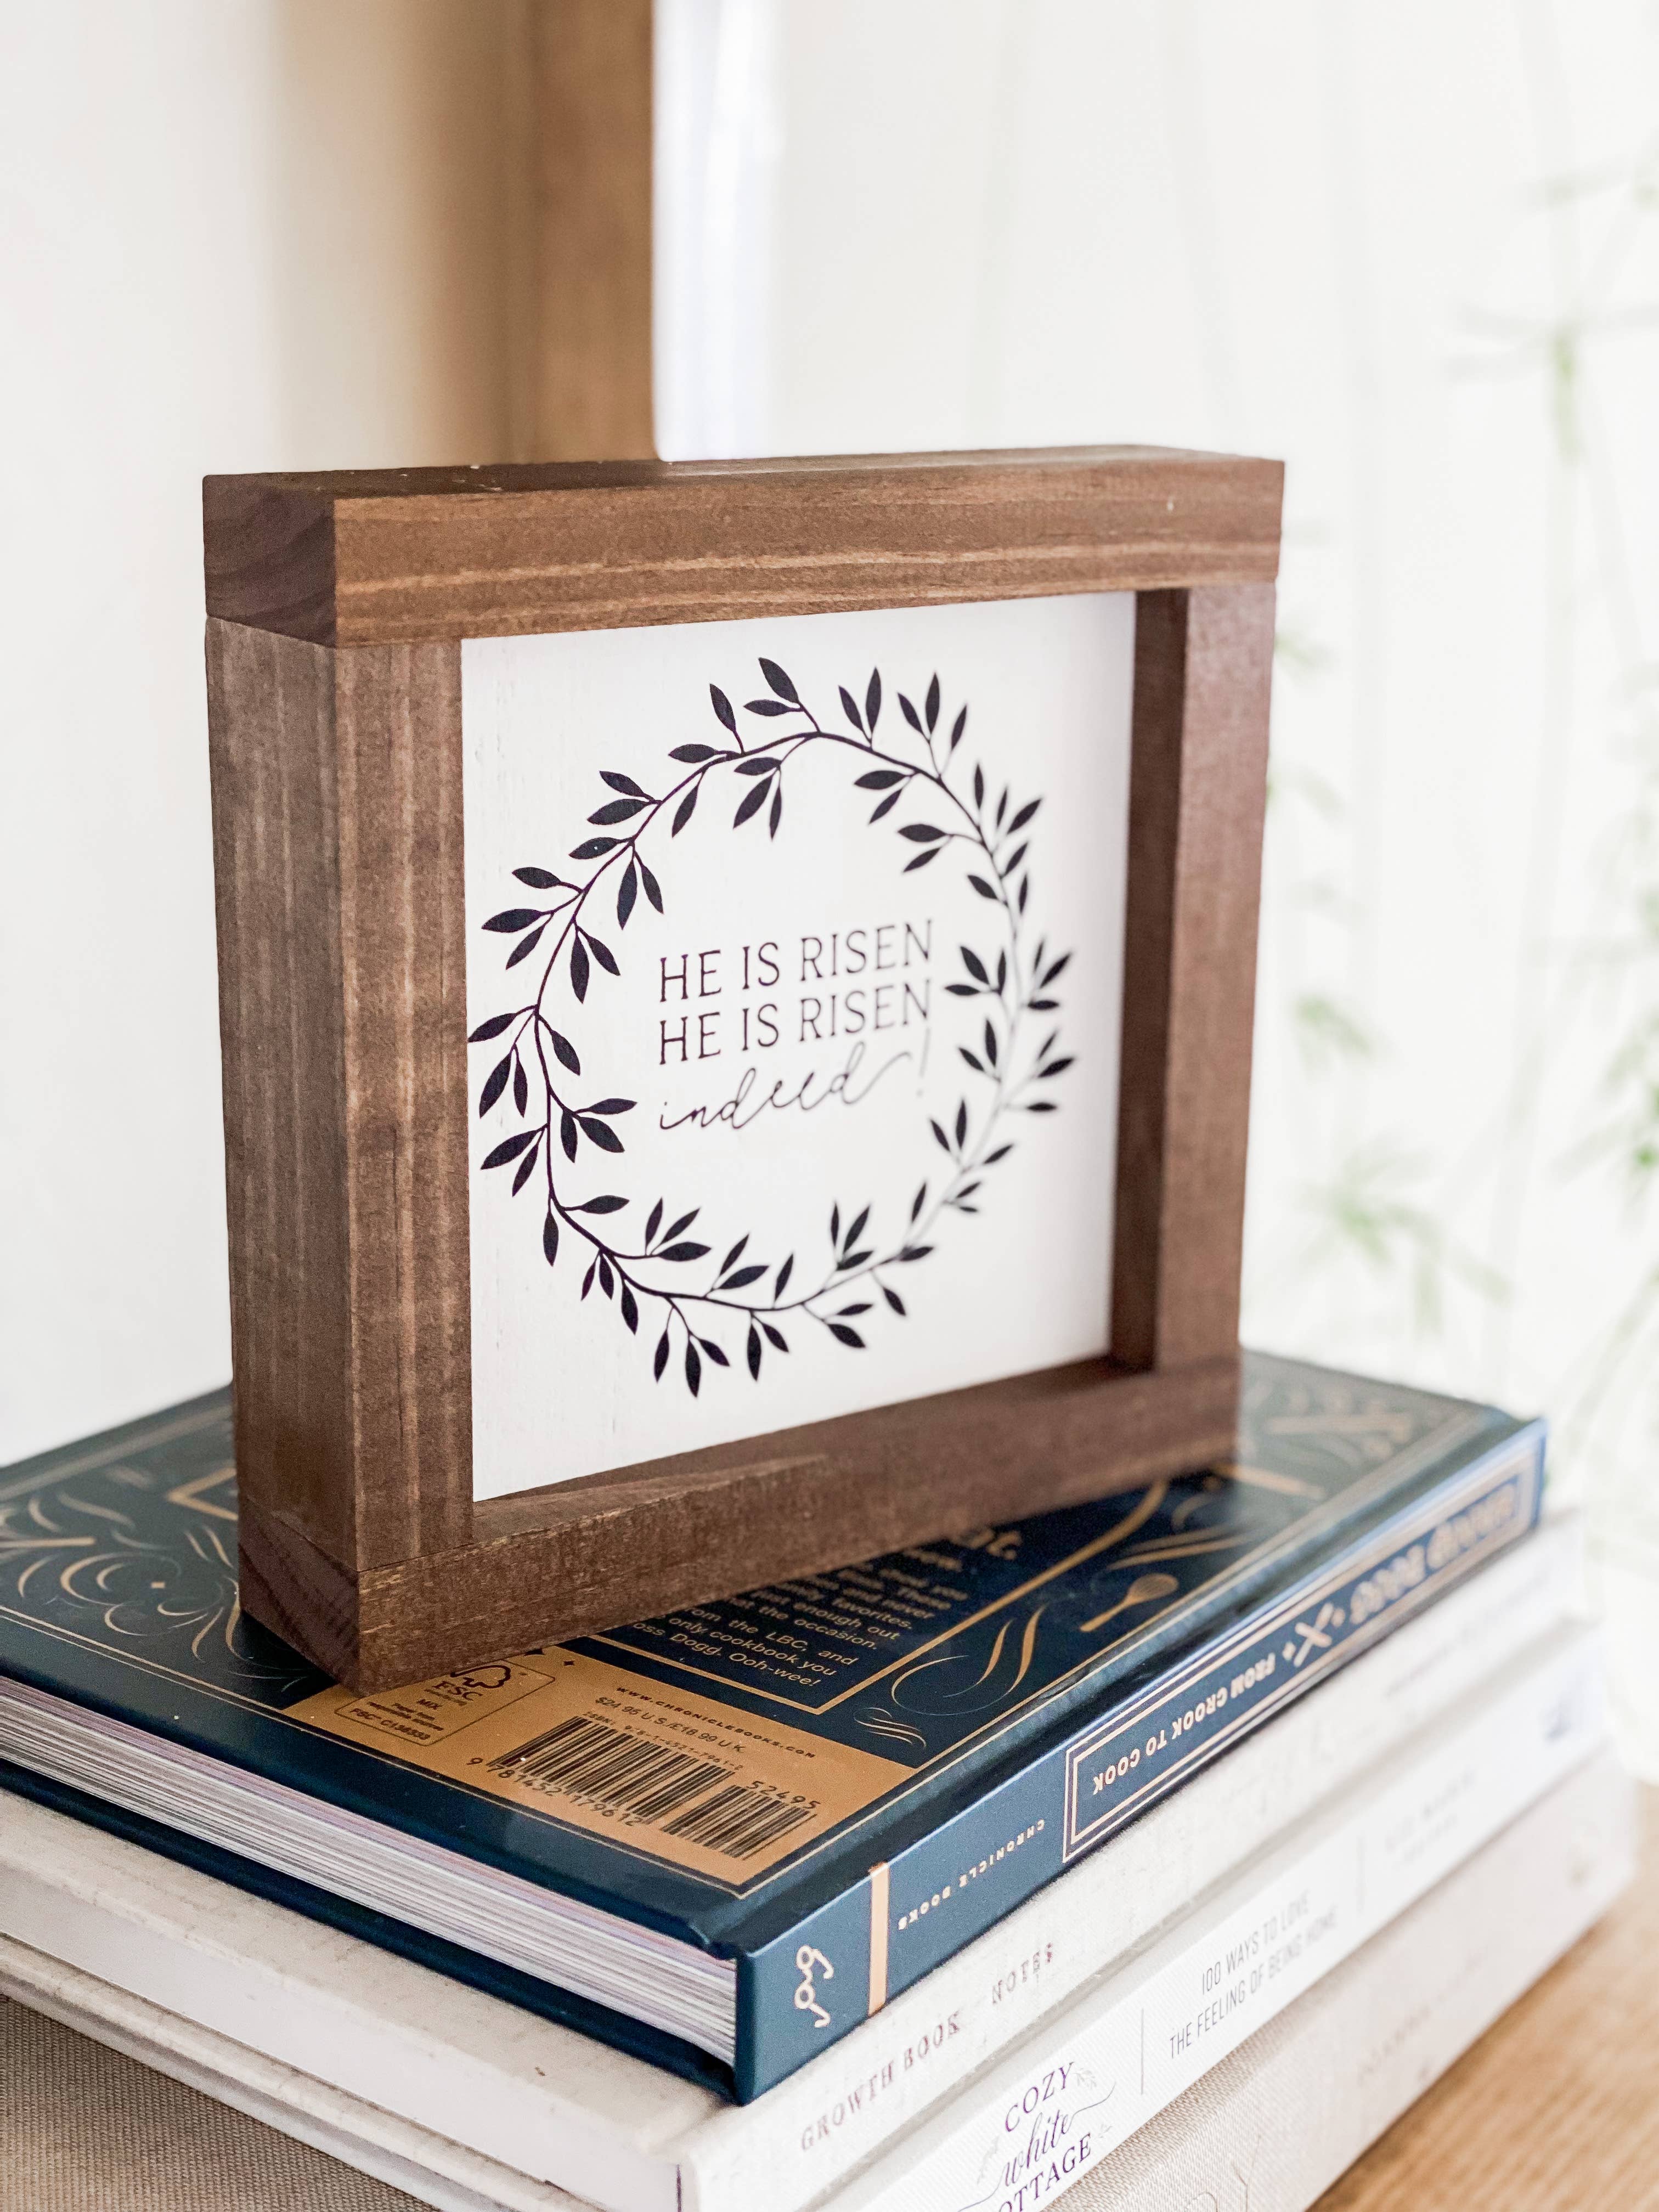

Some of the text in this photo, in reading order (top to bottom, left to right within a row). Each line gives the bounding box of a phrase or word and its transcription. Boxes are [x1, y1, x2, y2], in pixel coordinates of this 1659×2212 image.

[659, 919, 933, 1002] HE IS RISEN
[659, 978, 932, 1065] HE IS RISEN
[728, 1620, 759, 1634] the
[765, 1631, 809, 1652] LBC,
[817, 1650, 860, 1666] and
[759, 1605, 789, 1619] the
[794, 1618, 878, 1650] occasion.
[793, 1601, 863, 1628] enough
[867, 1626, 901, 1640] out
[831, 1596, 913, 1629] favorites.
[633, 1622, 821, 1687] oss Dogg. Ooh-wee!
[669, 1618, 838, 1677] only cookbook you
[432, 1680, 483, 1702] FSC
[1092, 1652, 1276, 1795] FROM CROOK TO COOK
[466, 1757, 484, 1765] 9
[746, 1780, 821, 1809] 52495
[898, 1819, 1045, 1931] CHRONICLE BOOKS
[1201, 1960, 1221, 1995] 100
[1226, 1930, 1260, 1976] WAYS
[1263, 1916, 1279, 1946] TO
[1170, 2022, 1193, 2059] THE
[1197, 1979, 1246, 2039] FEELING
[1250, 1963, 1264, 1995] OF
[800, 1942, 1053, 2152] GROWTH BOOK NOTES
[1005, 2061, 1075, 2132] COZY
